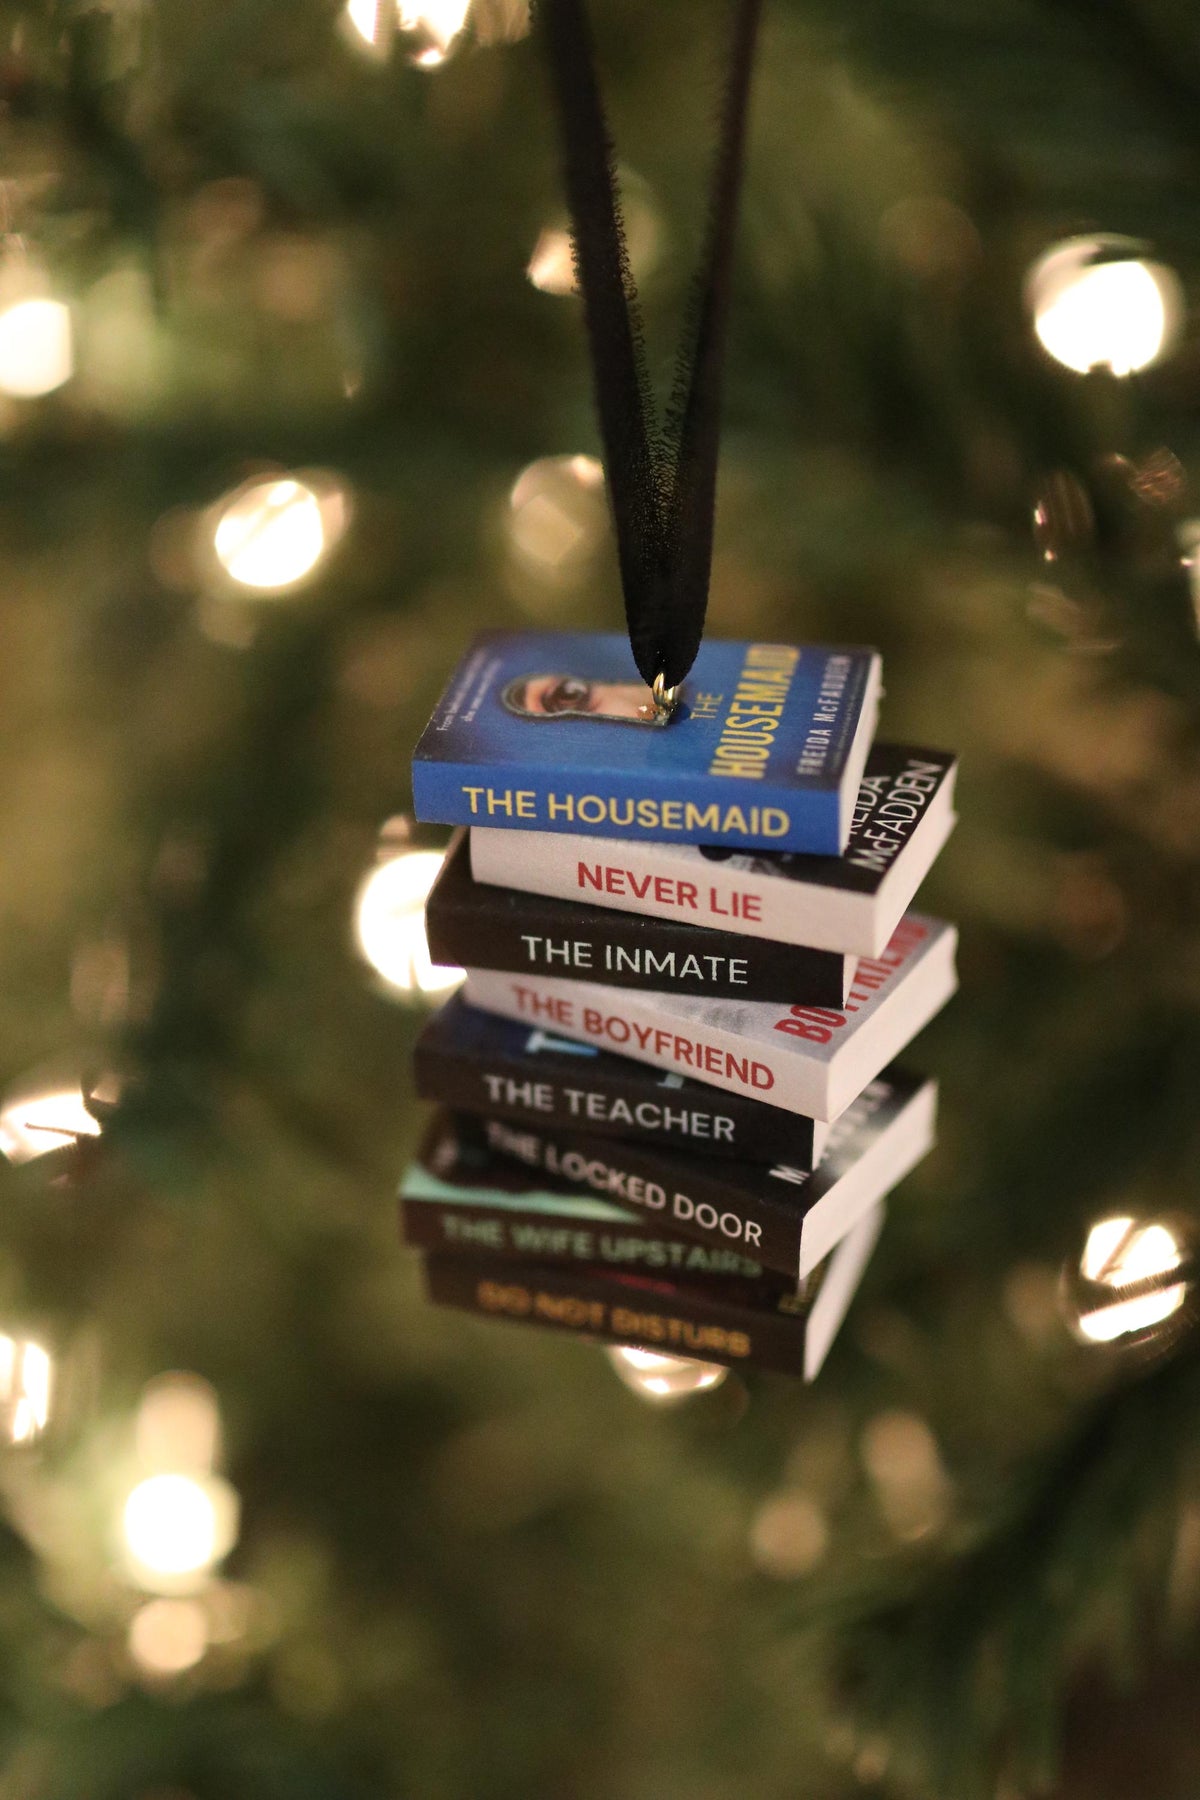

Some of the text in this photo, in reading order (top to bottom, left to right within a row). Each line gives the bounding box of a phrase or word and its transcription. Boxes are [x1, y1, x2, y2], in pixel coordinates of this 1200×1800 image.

[690, 690, 723, 720] THE
[708, 643, 800, 779] HOUSEMAID
[462, 786, 791, 839] THE HOUSEMAID
[848, 759, 944, 873] McFADDEN
[577, 862, 763, 922] NEVER LIE
[521, 935, 749, 985] THE INMATE
[510, 985, 574, 1028] THE
[583, 1008, 775, 1091] BOYFRIEND
[484, 1073, 554, 1112] THE
[565, 1088, 736, 1142] TEACHER
[545, 1144, 667, 1210] LOCKED
[673, 1193, 763, 1247] DOOR
[442, 1215, 503, 1244] THE
[512, 1224, 593, 1260] WIFE
